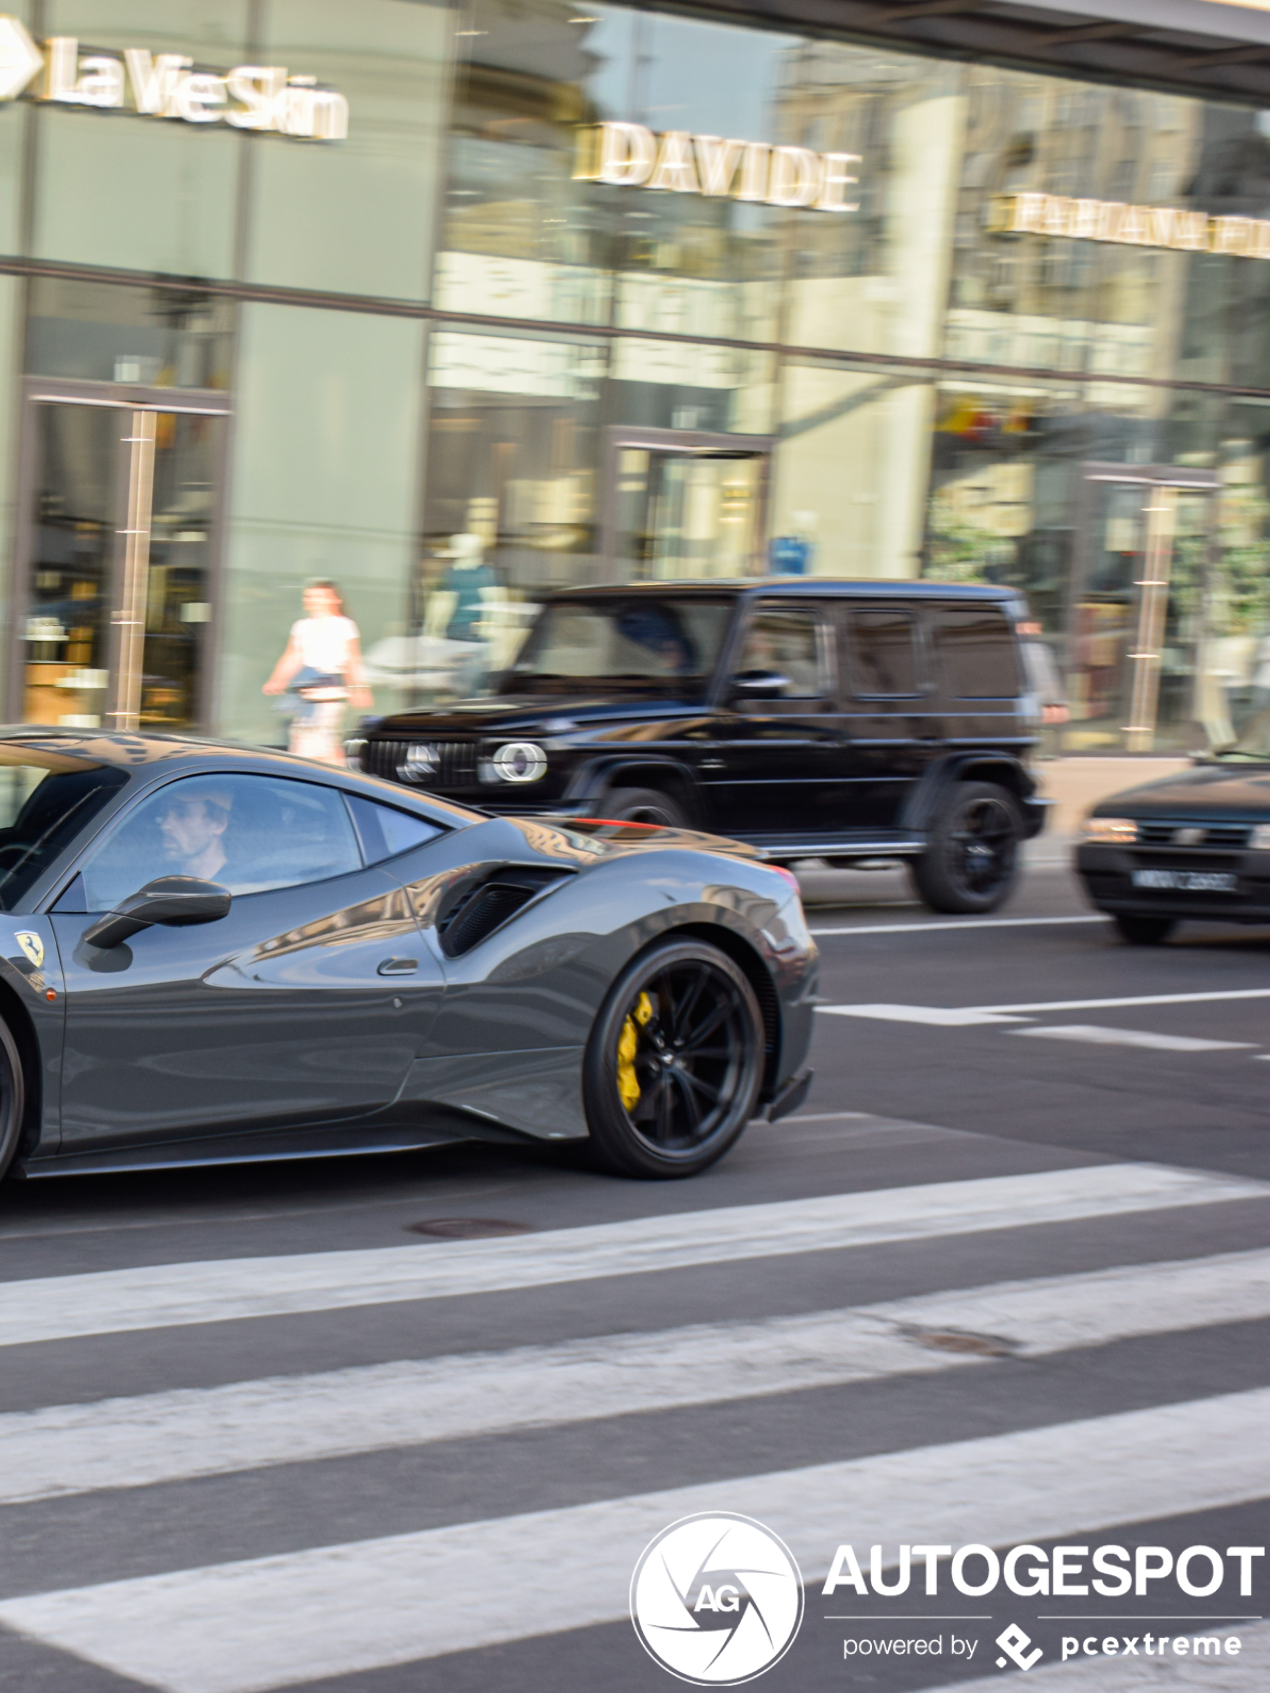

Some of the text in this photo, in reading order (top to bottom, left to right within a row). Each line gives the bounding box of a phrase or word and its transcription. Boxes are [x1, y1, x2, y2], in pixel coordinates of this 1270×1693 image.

[45, 37, 349, 139] La Vie Skin
[591, 121, 863, 212] DAVIDE
